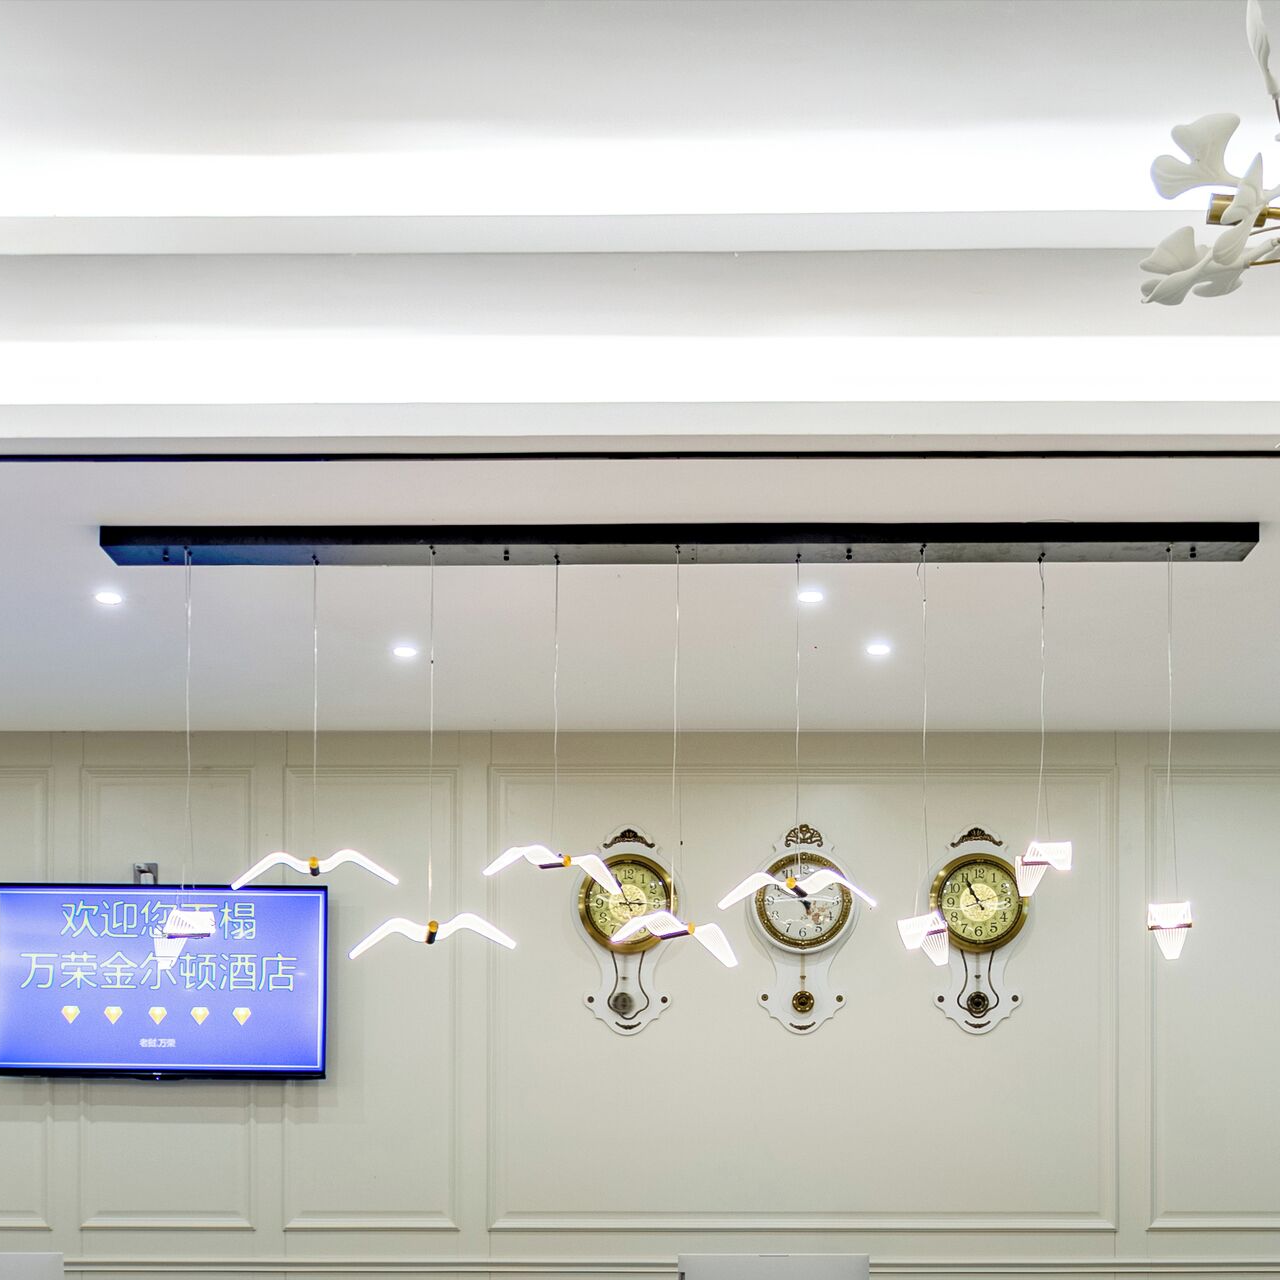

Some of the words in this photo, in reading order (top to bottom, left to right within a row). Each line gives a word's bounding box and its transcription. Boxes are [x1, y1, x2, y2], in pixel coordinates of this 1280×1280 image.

[623, 868, 634, 879] 12
[640, 873, 645, 884] 1
[974, 868, 984, 879] 12
[992, 873, 996, 882] 1
[950, 883, 960, 893] 10
[595, 898, 604, 908] 9
[947, 897, 955, 907] 9
[600, 912, 607, 923] 8
[950, 912, 958, 922] 8
[1000, 912, 1008, 922] 4
[610, 924, 616, 934] 7
[961, 923, 968, 933] 7
[974, 926, 982, 936] 6
[990, 922, 997, 933] 5
[20, 950, 298, 992] 万荣金尔顿酒店
